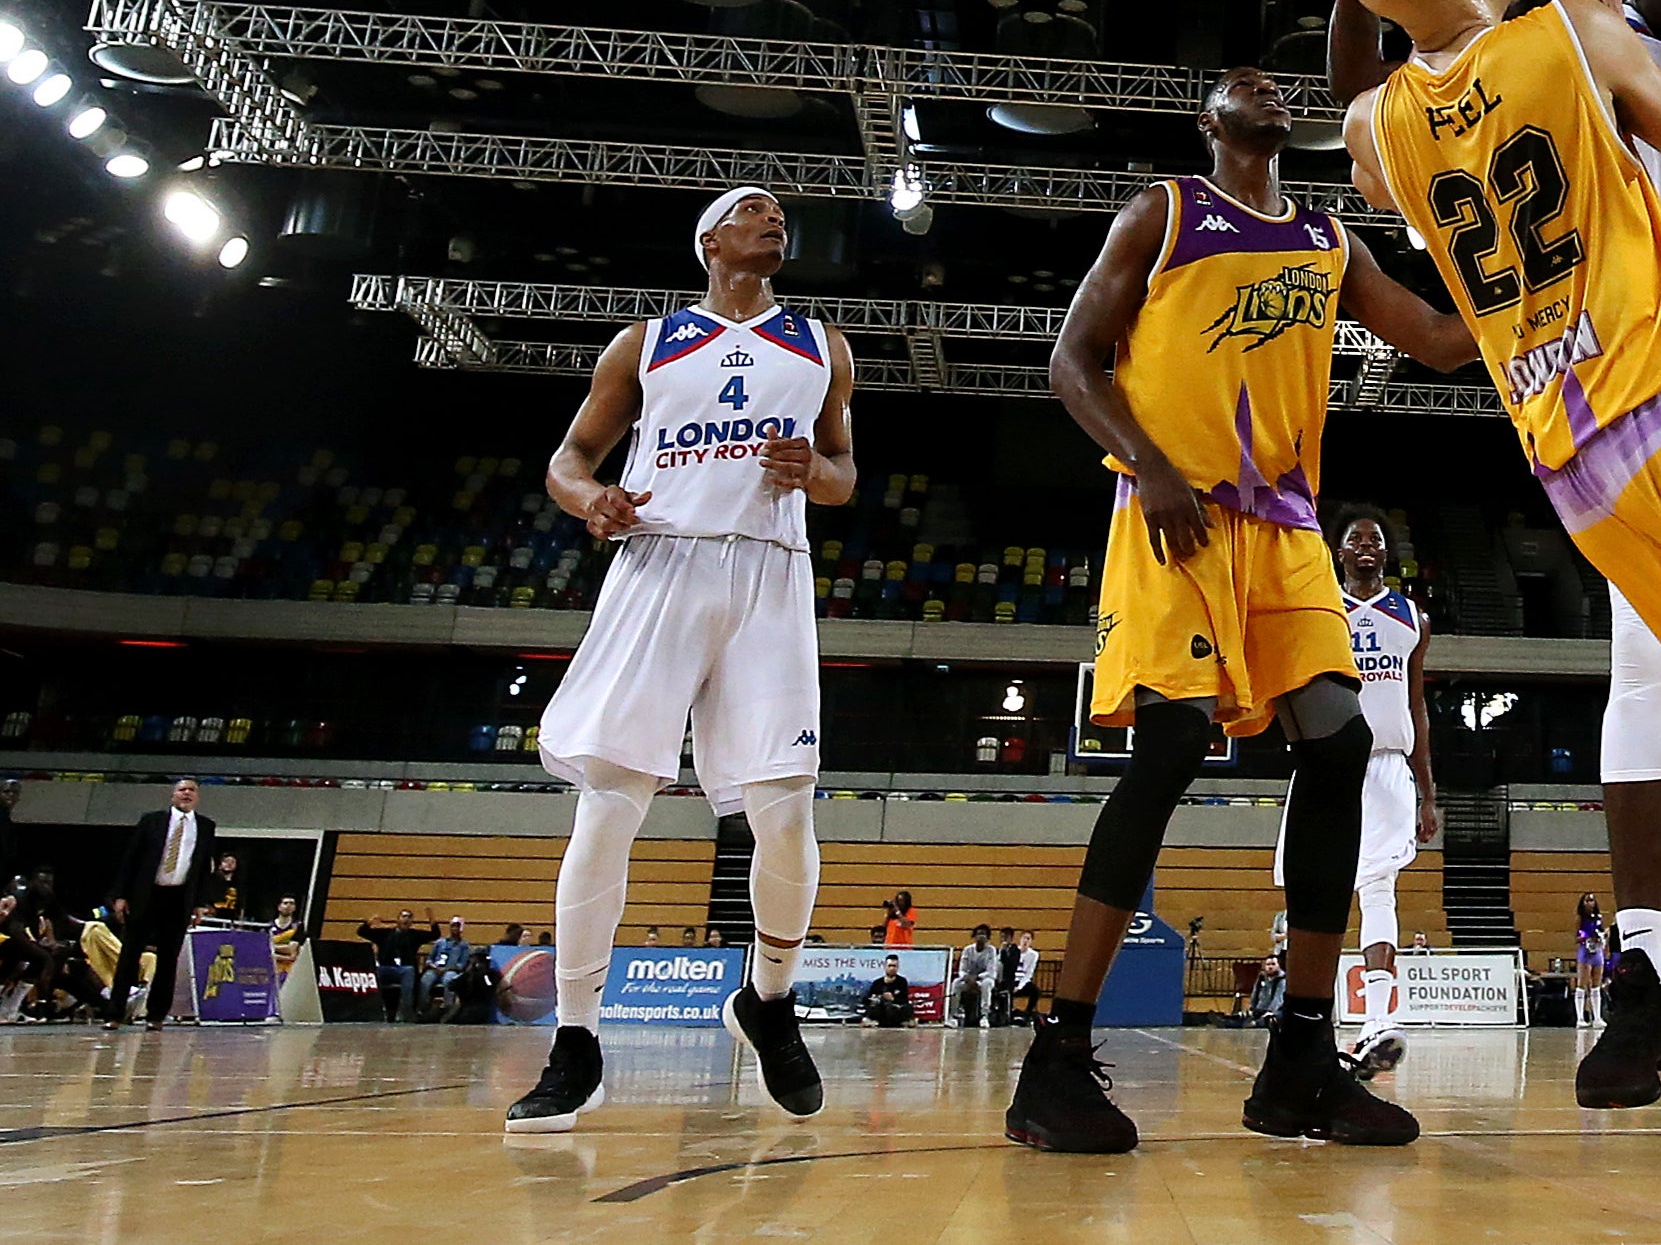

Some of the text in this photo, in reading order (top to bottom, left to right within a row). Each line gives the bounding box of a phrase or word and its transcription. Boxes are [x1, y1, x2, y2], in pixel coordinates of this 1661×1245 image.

[1427, 123, 1586, 318] 22
[1303, 223, 1331, 250] 15
[1284, 268, 1332, 293] LONDON
[1526, 295, 1571, 332] MERCY
[718, 375, 750, 411] 4
[656, 441, 765, 469] CITY ROY
[1352, 631, 1381, 652] 11
[1354, 654, 1403, 671] NDON
[626, 957, 724, 981] molten
[802, 957, 830, 969] MISS
[834, 958, 856, 969] THE
[1407, 967, 1492, 981] GLL SPORT
[332, 966, 379, 994] Kappa
[1408, 986, 1508, 1001] FOUNDATION
